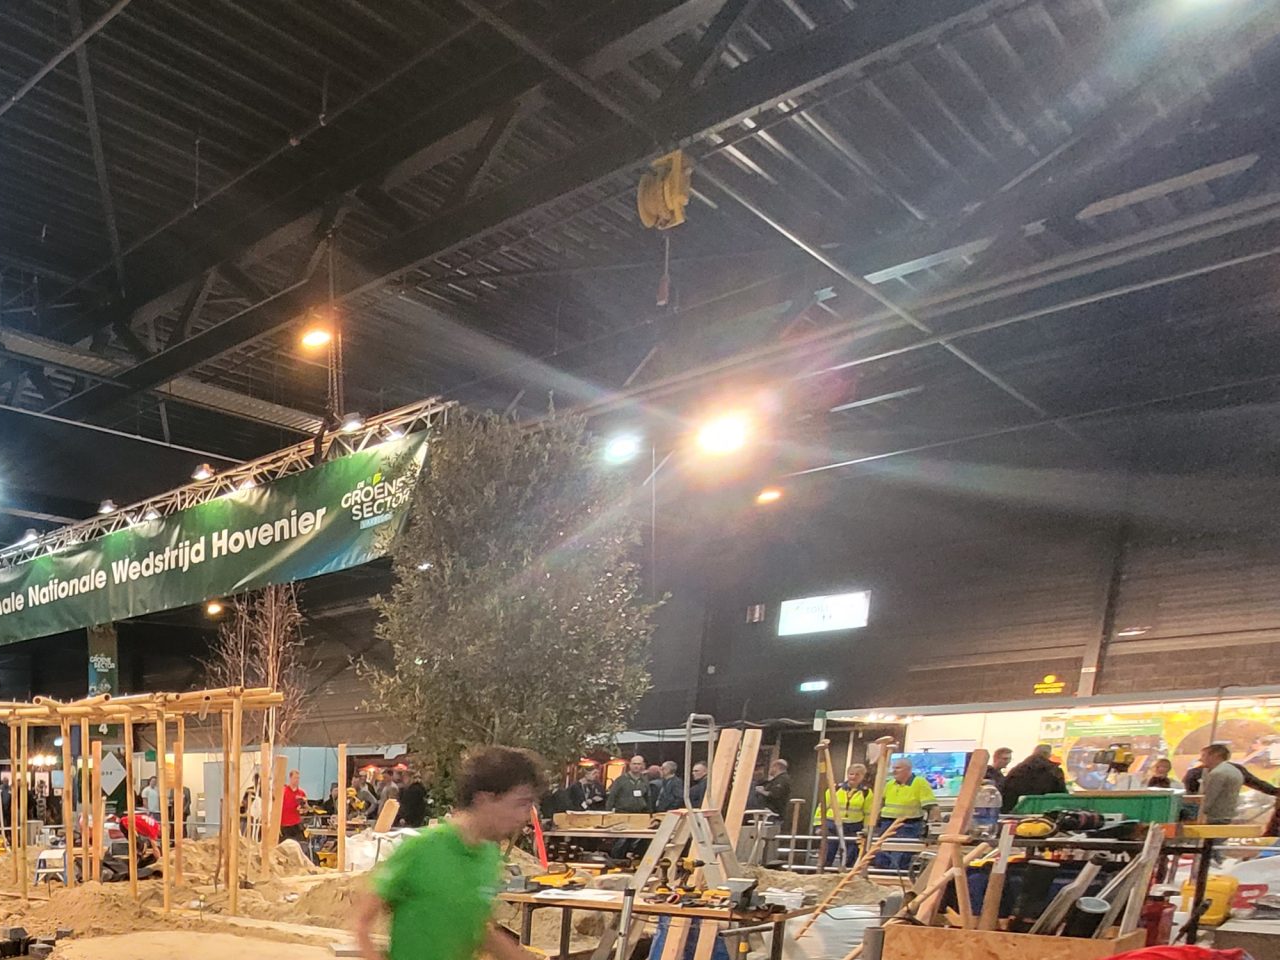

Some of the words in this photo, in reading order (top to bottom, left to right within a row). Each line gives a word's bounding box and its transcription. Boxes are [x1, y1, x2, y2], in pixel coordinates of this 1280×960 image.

[28, 568, 107, 607] Nationale
[111, 535, 205, 585] Wedstrijd
[212, 507, 327, 559] Hovenier
[99, 723, 108, 735] 4
